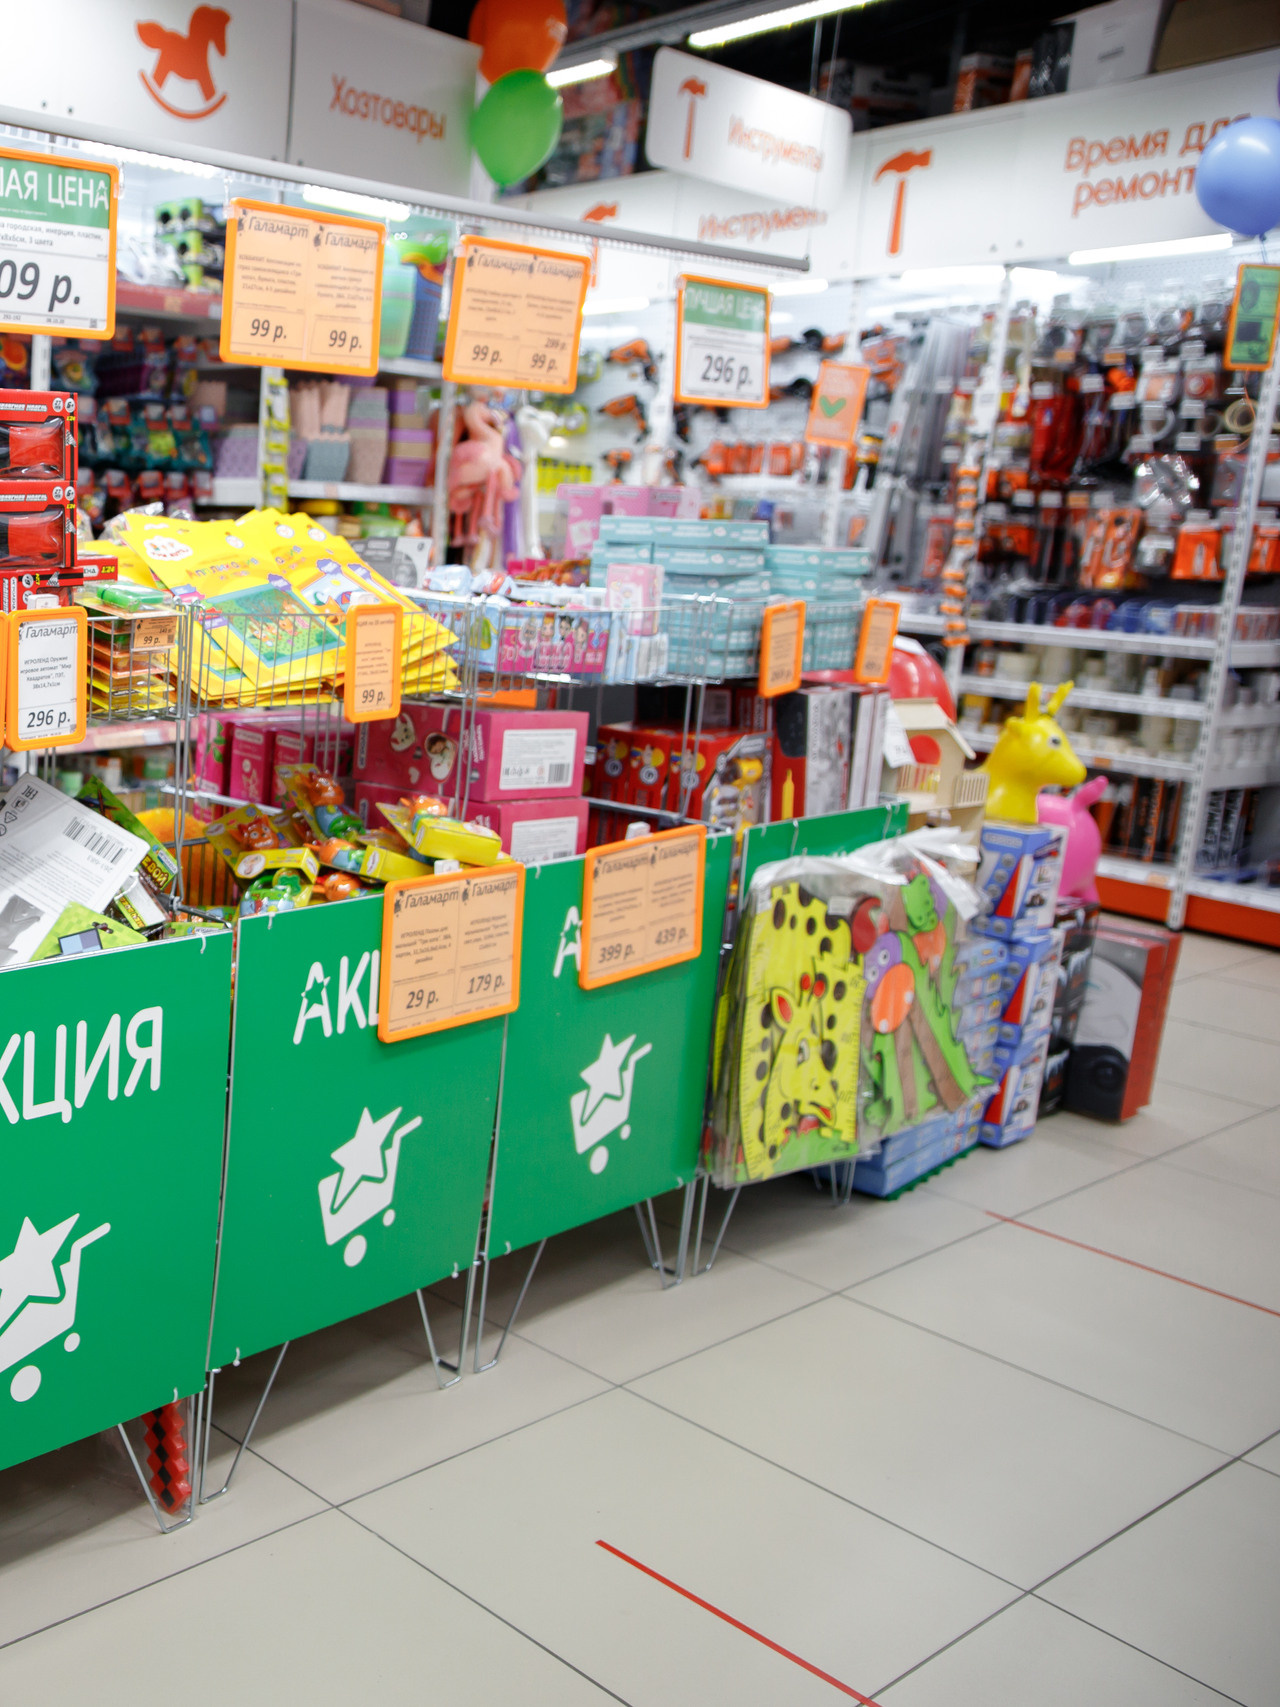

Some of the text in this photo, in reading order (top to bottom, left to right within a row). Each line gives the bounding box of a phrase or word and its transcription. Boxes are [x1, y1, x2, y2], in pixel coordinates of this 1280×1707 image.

[329, 72, 447, 145] Хозтовары
[1065, 128, 1170, 177] Время
[48, 172, 110, 210] ЦЕНА
[1072, 165, 1197, 218] ремонт
[248, 216, 309, 241] Галамарт
[324, 232, 380, 254] Галамарт
[48, 274, 81, 313] р.
[249, 318, 288, 343] 99 р.
[328, 330, 363, 353] 99 р.
[471, 344, 504, 366] 99 р.
[529, 353, 559, 373] 99 р.
[701, 354, 754, 391] 296 р.
[143, 636, 161, 645] 99 р.
[361, 689, 386, 704] 99 р.
[26, 709, 71, 729] 296 р.
[471, 877, 518, 897] Галамарт
[404, 889, 459, 909] Галамарт
[654, 926, 677, 946] 439
[598, 942, 636, 964] 399 р.
[466, 973, 506, 995] 179 р.
[405, 988, 439, 1010] 29 р.
